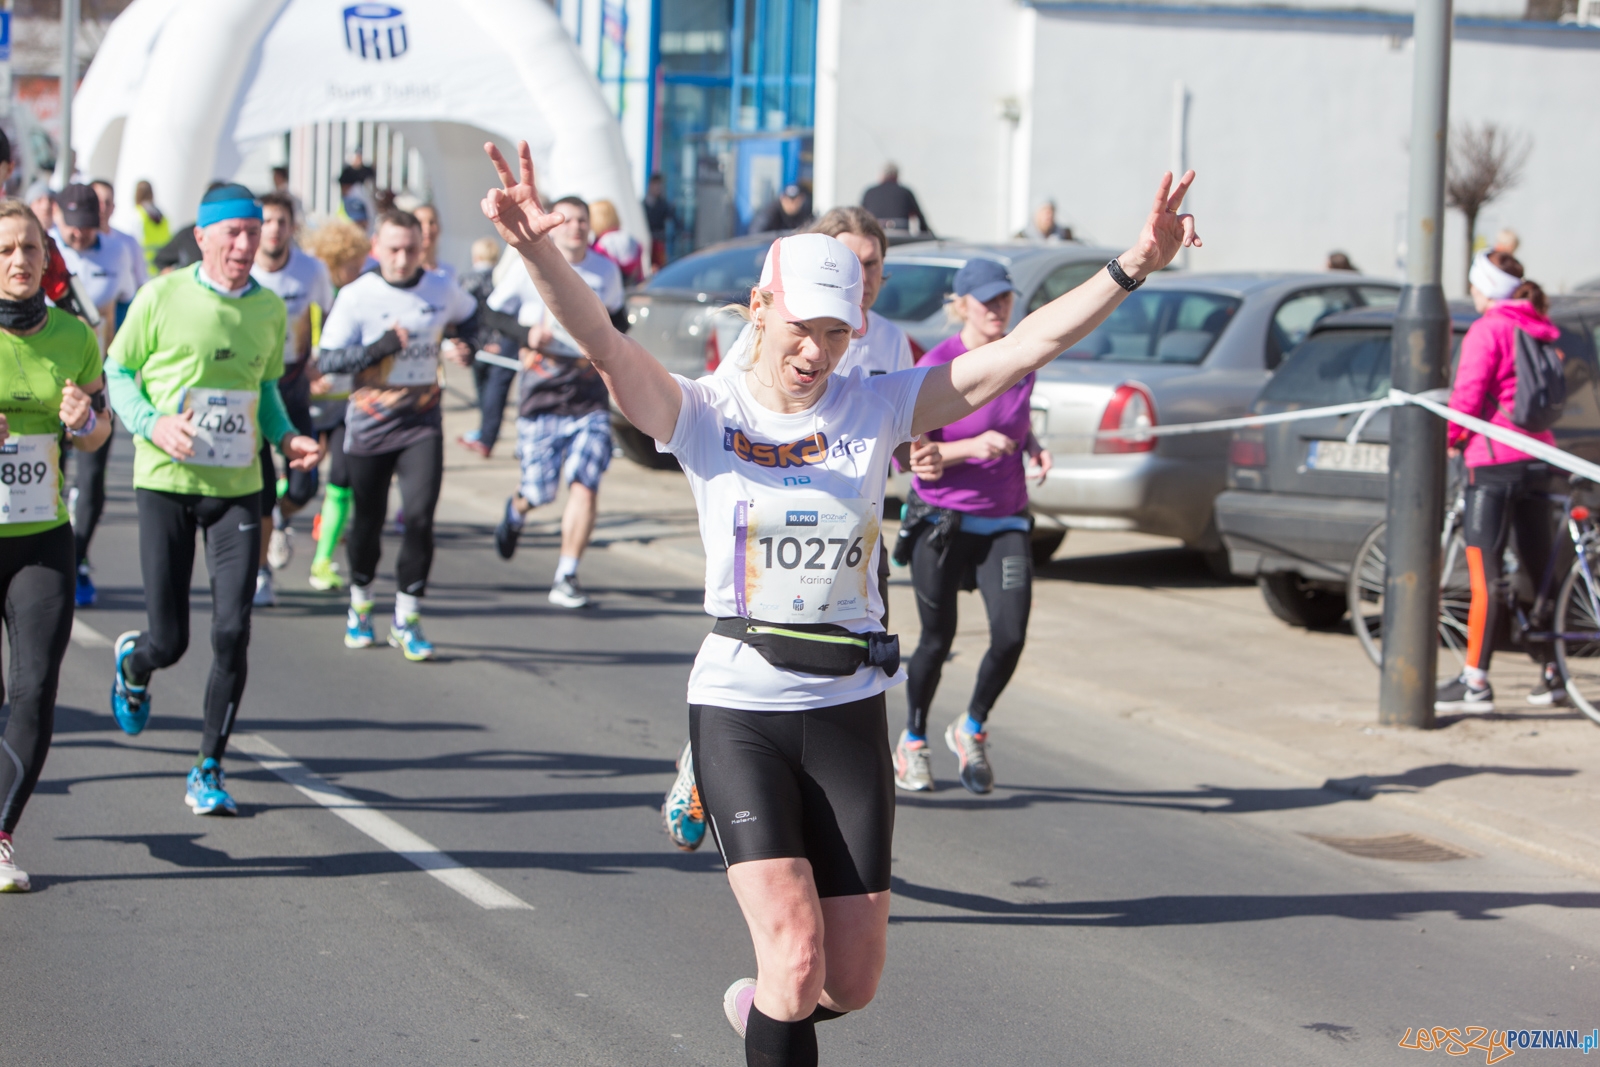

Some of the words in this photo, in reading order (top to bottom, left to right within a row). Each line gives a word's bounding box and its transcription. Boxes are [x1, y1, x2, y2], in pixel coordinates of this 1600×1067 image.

[199, 413, 246, 434] 4762
[1, 461, 47, 485] 889
[783, 475, 811, 487] na
[789, 514, 799, 522] 10.
[800, 514, 816, 522] PKO
[759, 536, 863, 570] 10276
[800, 575, 832, 585] Karina
